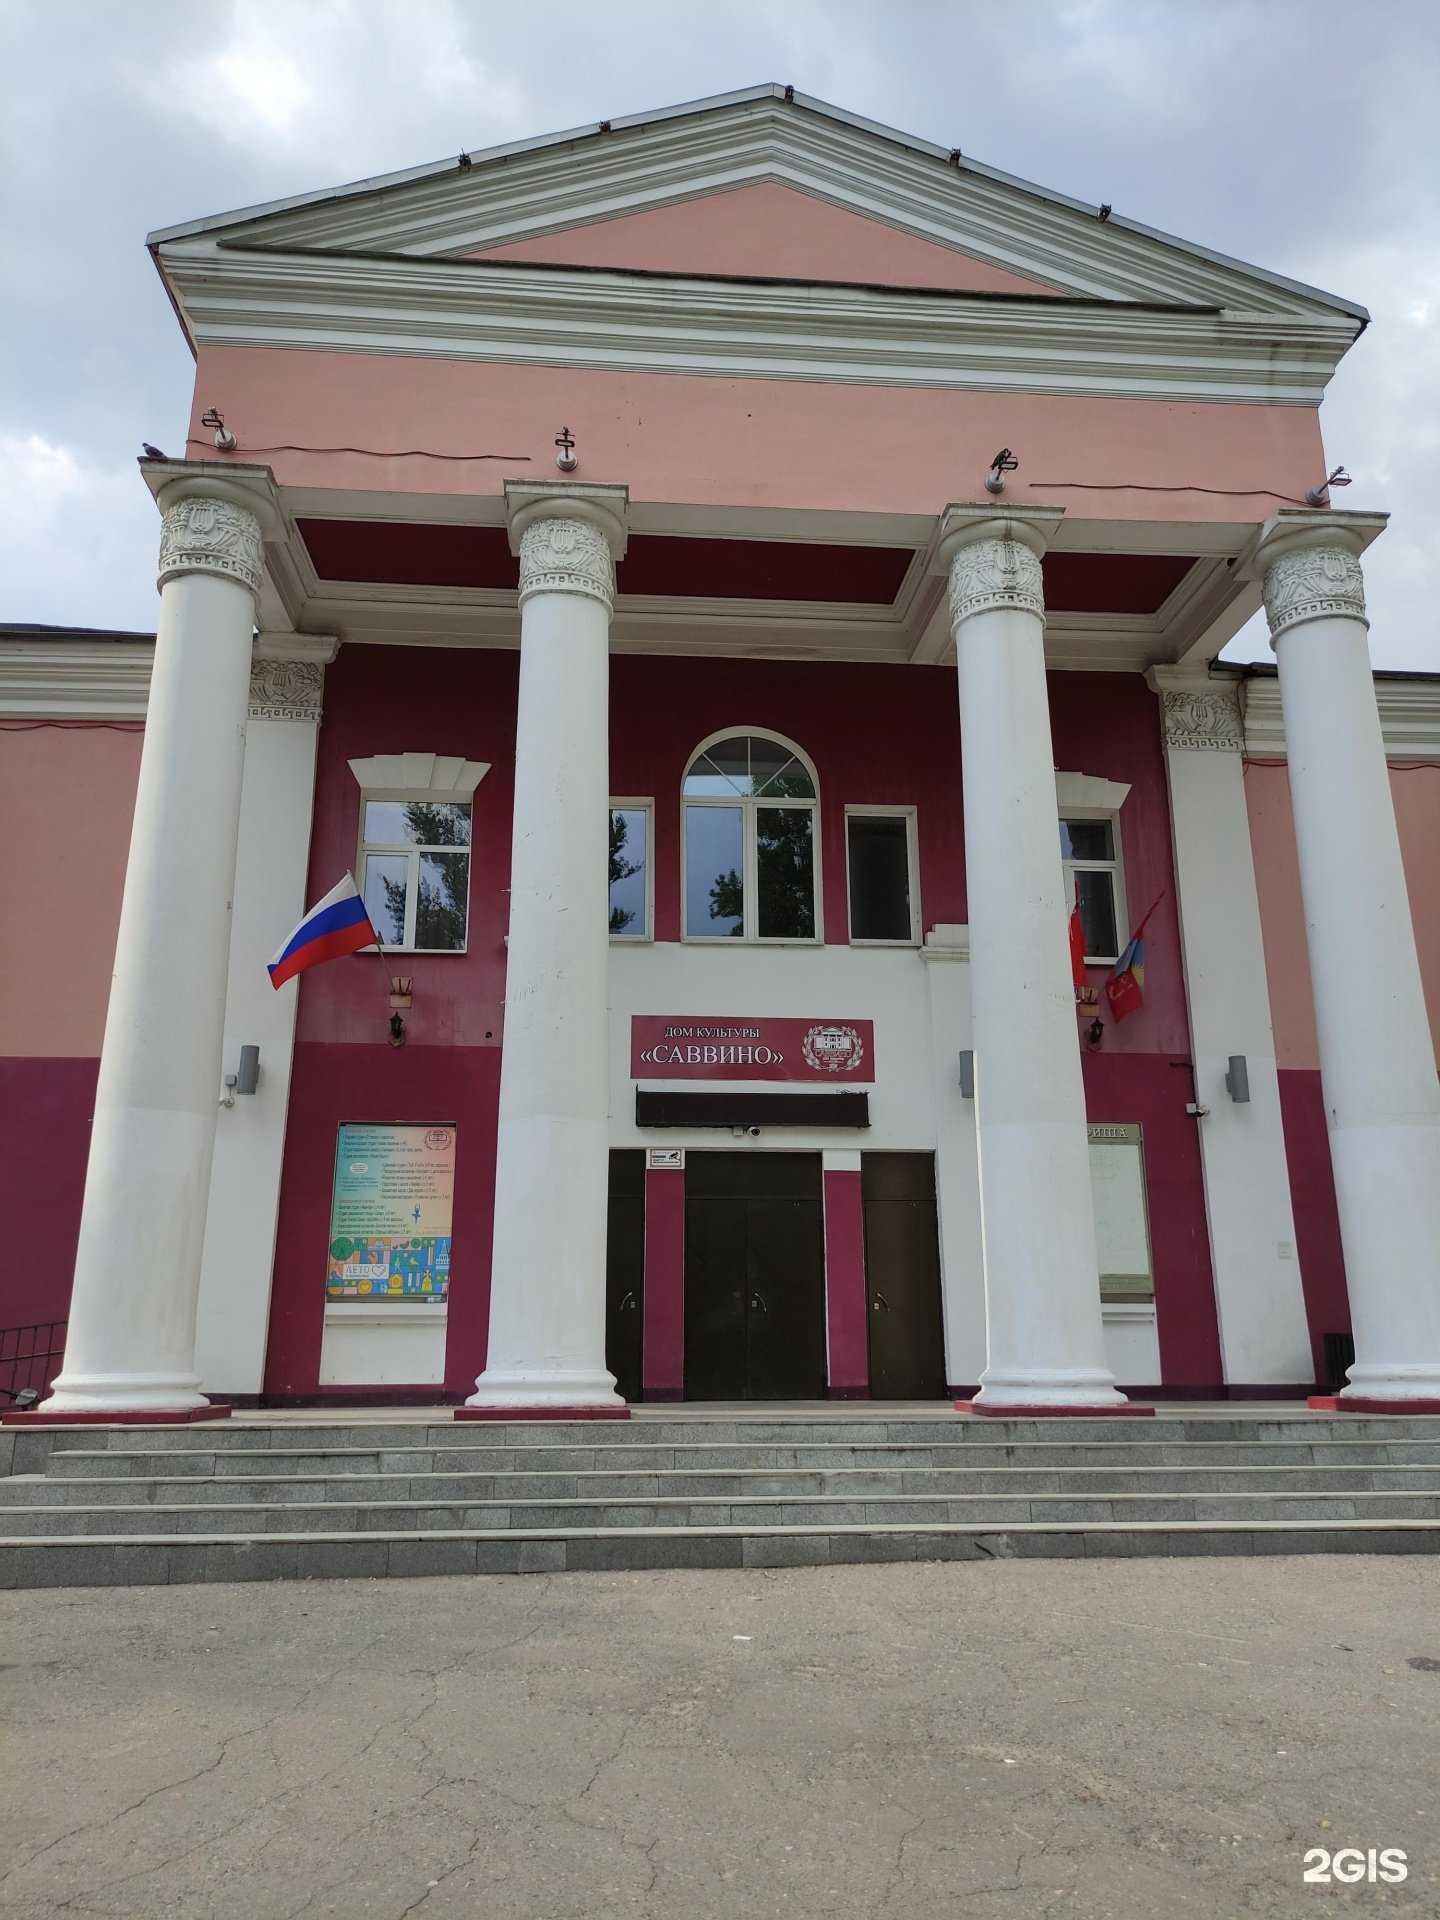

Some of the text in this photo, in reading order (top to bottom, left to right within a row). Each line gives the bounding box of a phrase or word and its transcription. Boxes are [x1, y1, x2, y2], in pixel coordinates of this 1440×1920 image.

[664, 1027, 760, 1038] ДОМ КУЛЬТУРЫ
[640, 1045, 784, 1064] «САВВИНО»
